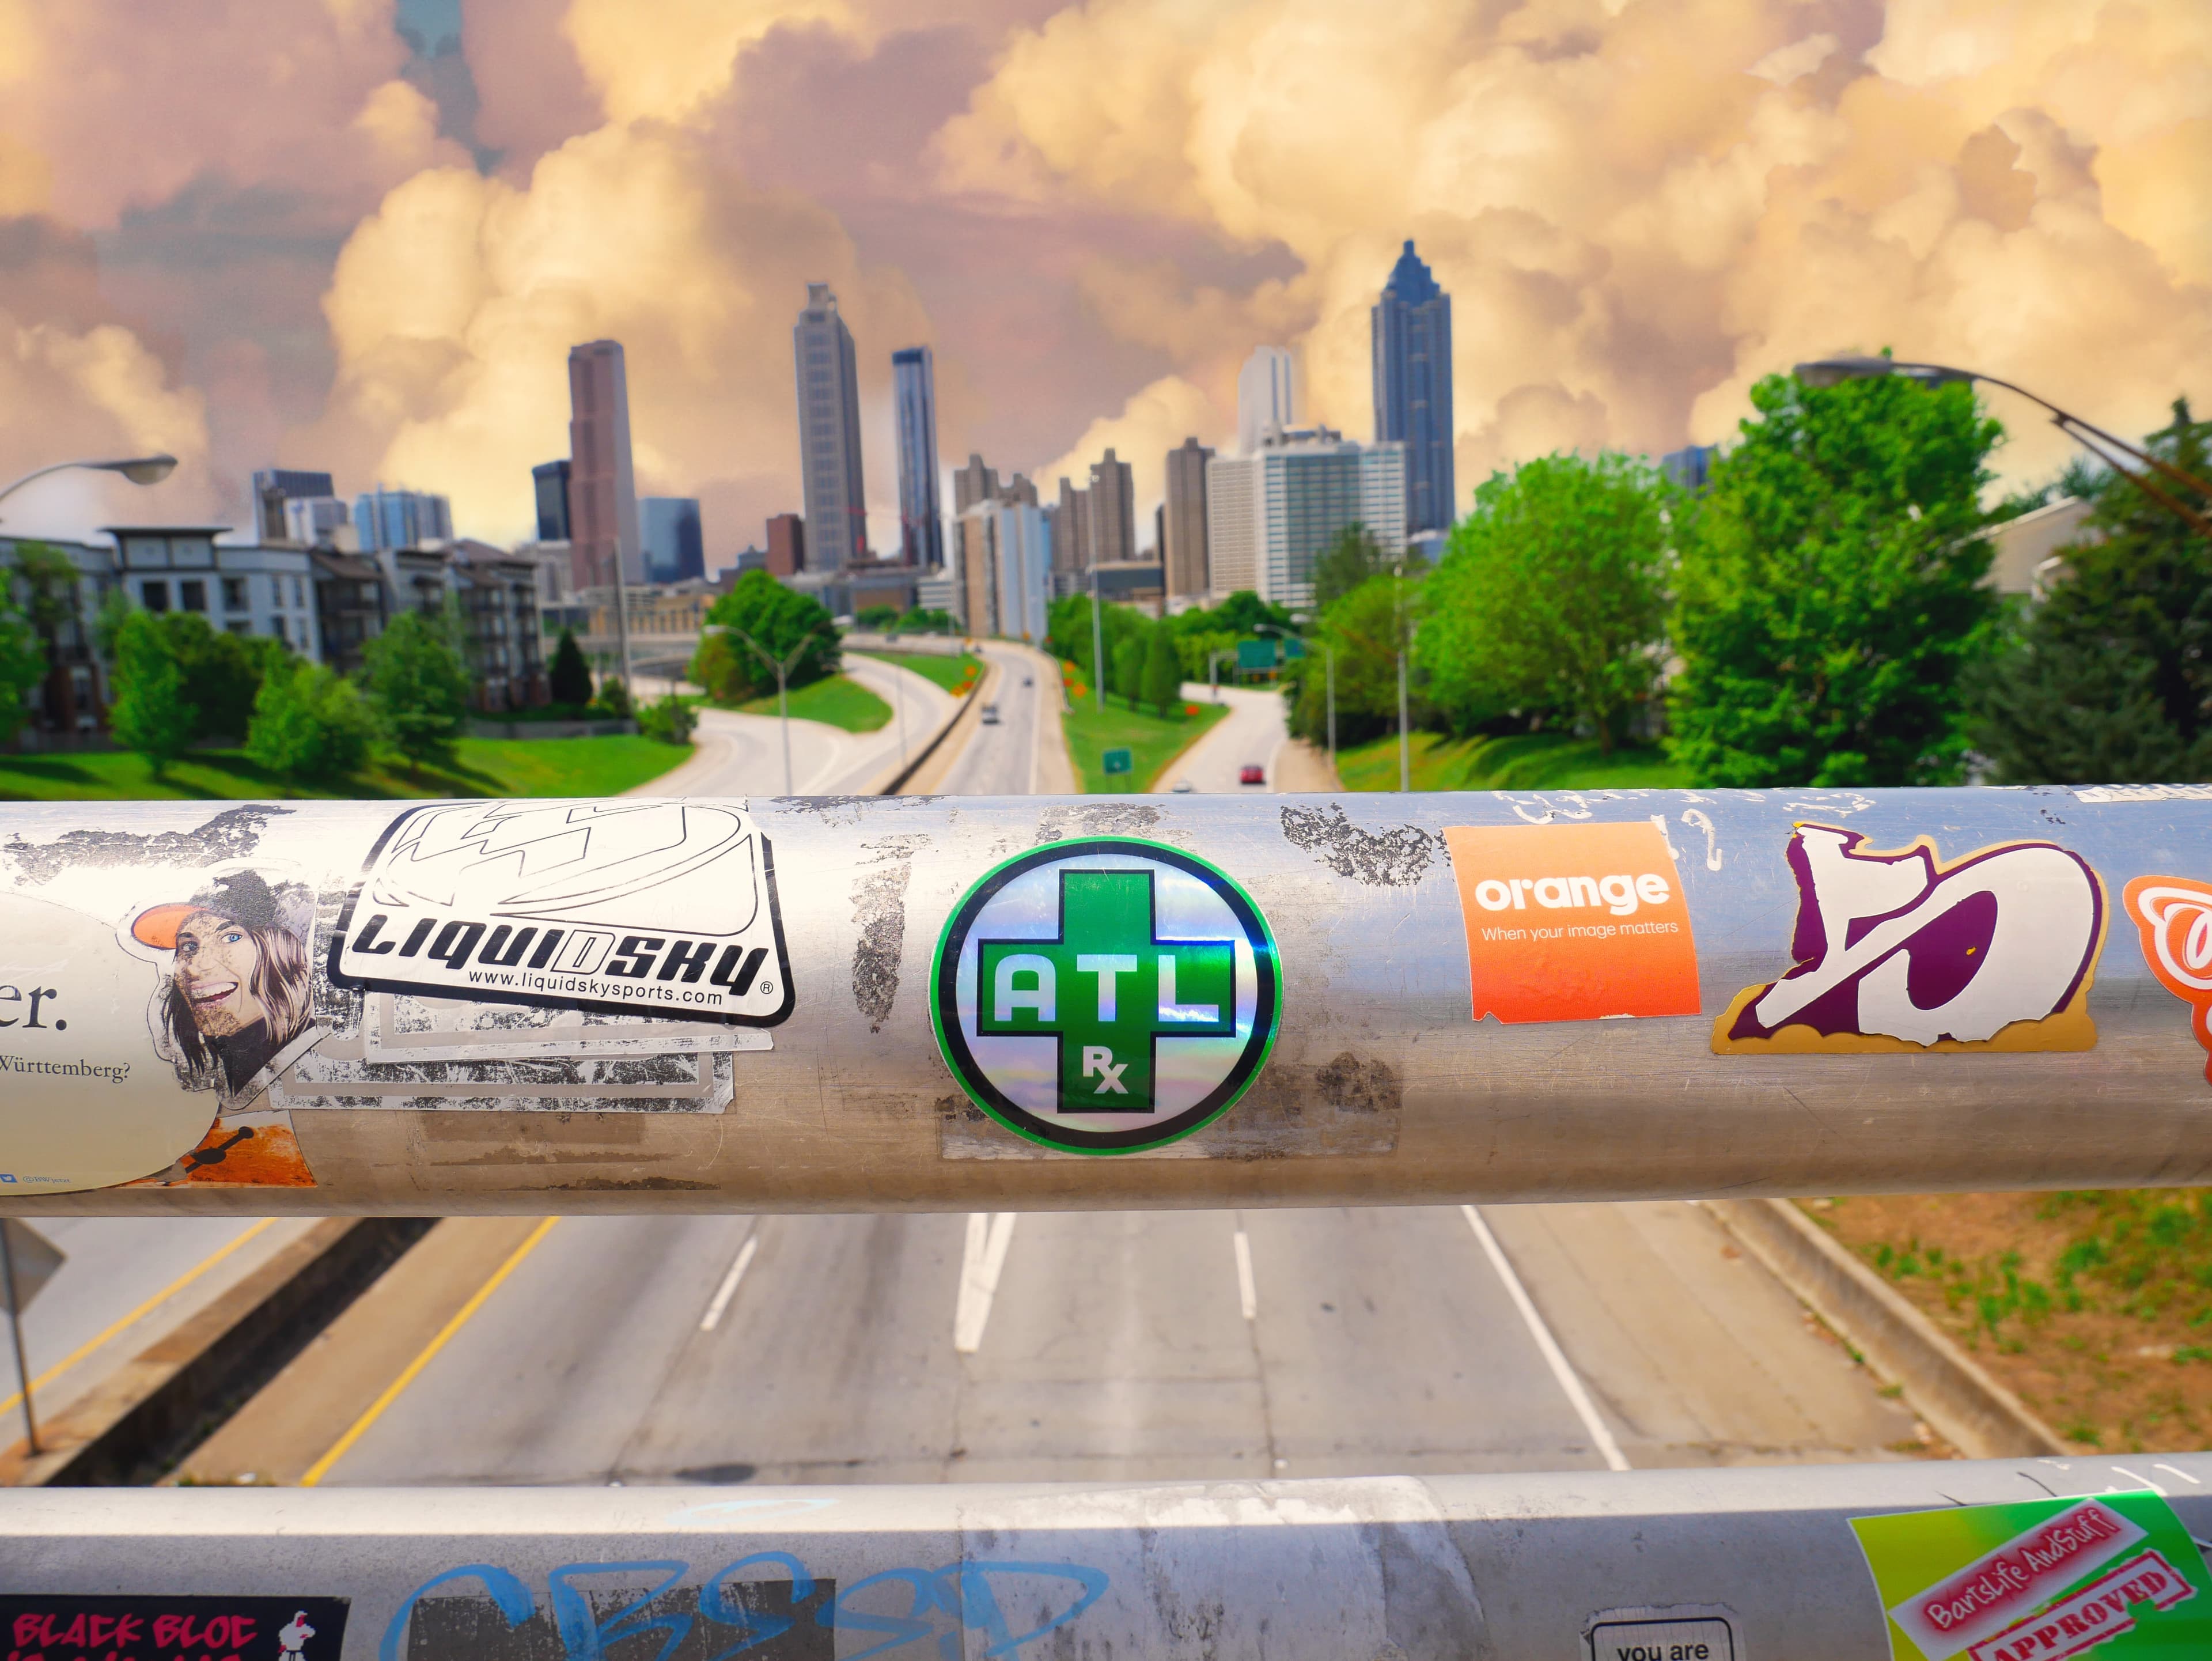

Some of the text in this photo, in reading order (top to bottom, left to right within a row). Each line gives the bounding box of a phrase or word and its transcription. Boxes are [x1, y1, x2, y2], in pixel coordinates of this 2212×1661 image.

[1475, 873, 1669, 915] orange
[1482, 922, 1679, 941] When your image matters
[469, 969, 722, 1005] www.liquidskysports.com
[994, 954, 1219, 1022] ATL
[13, 1613, 258, 1648] BLACK BLOC
[1994, 1571, 2168, 1661] APPROVED
[1617, 1644, 1709, 1661] you are
